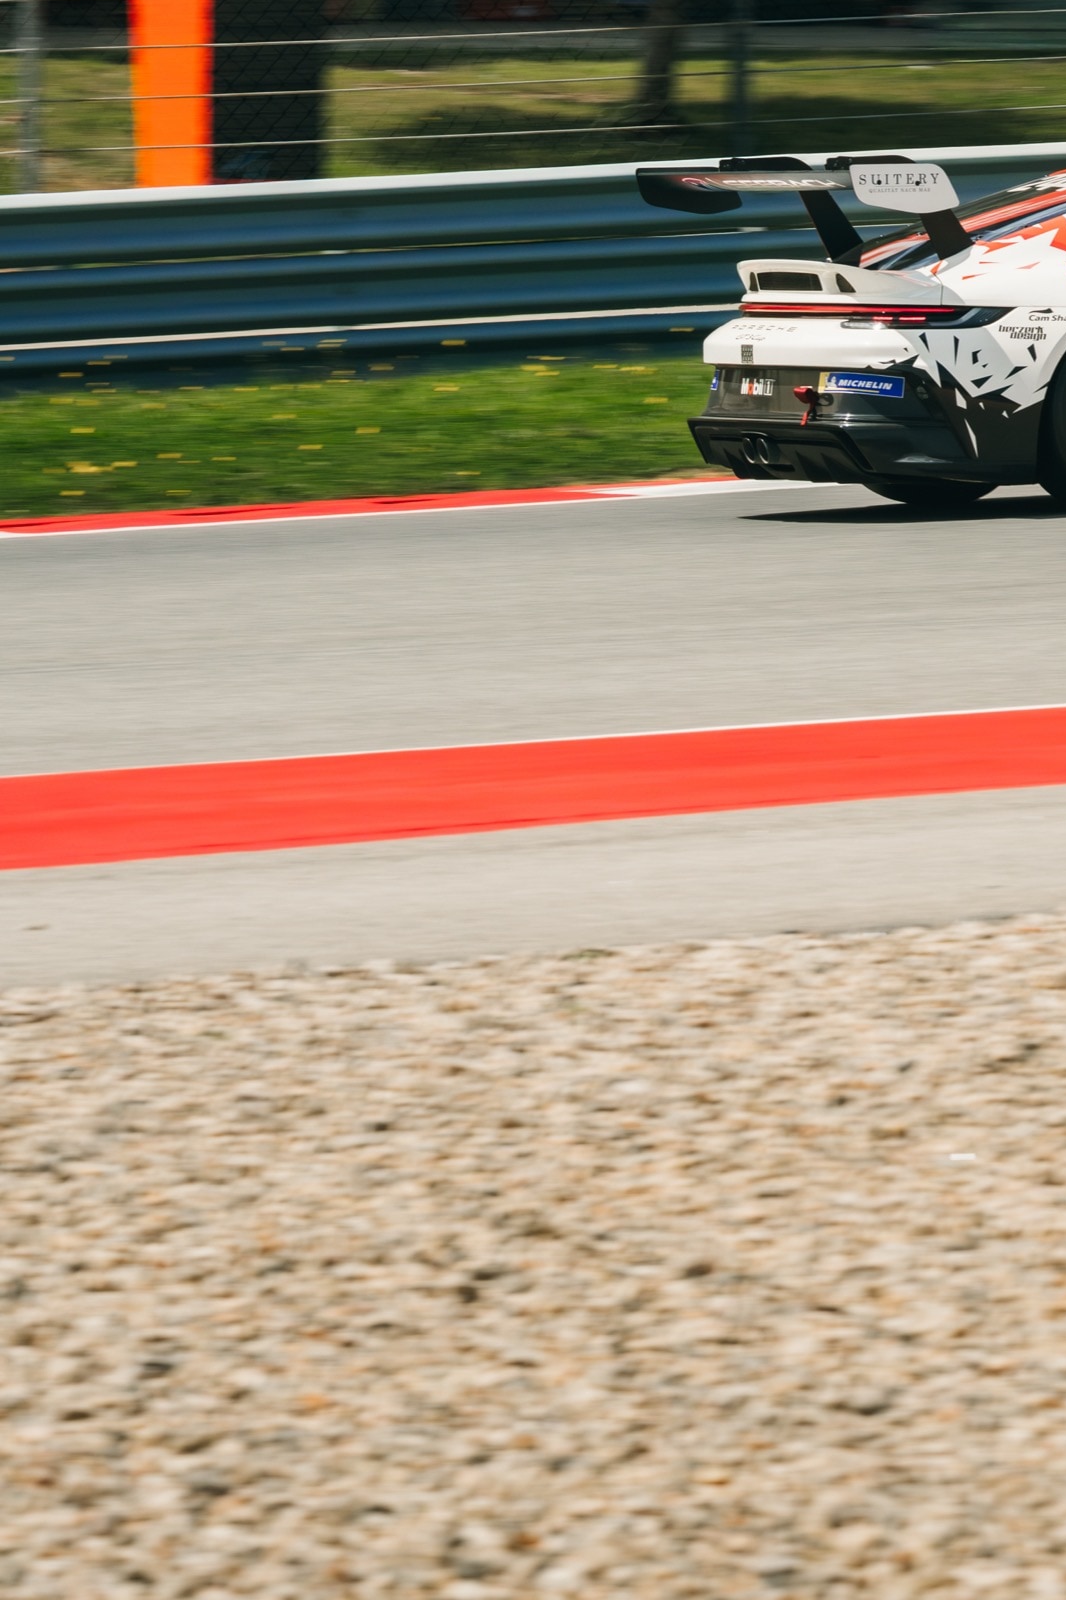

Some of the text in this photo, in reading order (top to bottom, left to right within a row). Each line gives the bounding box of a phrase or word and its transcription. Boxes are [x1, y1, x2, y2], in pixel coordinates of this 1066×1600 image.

[858, 173, 940, 186] SUITERY
[1028, 314, 1050, 322] Cam
[740, 377, 764, 396] Mobil
[837, 378, 893, 391] MICHELIN
